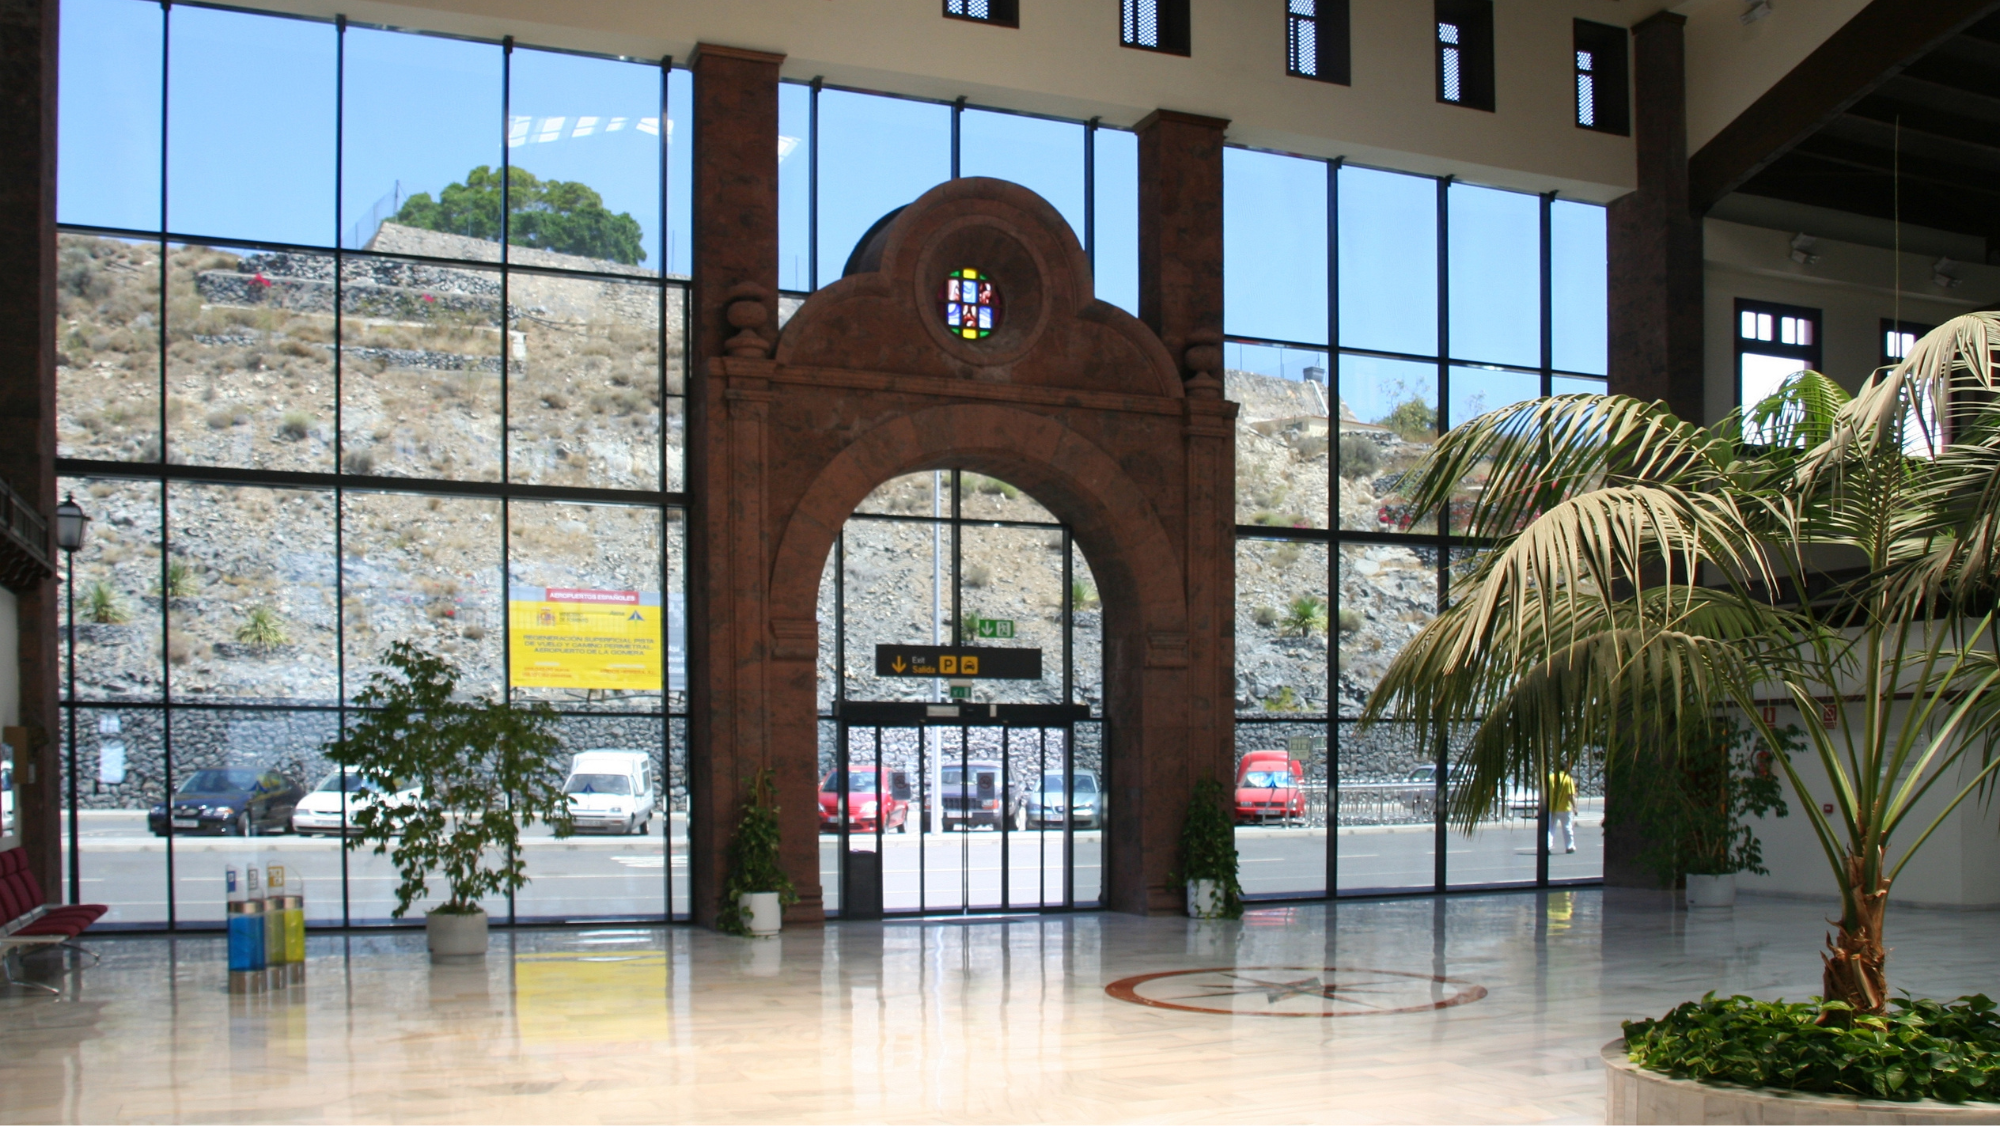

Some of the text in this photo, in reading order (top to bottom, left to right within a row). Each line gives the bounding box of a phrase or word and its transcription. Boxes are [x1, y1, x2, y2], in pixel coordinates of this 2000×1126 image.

[549, 592, 635, 602] AEROPUERTOS ESPAÑOLES
[912, 656, 925, 664] Exit
[912, 666, 936, 674] Salida
